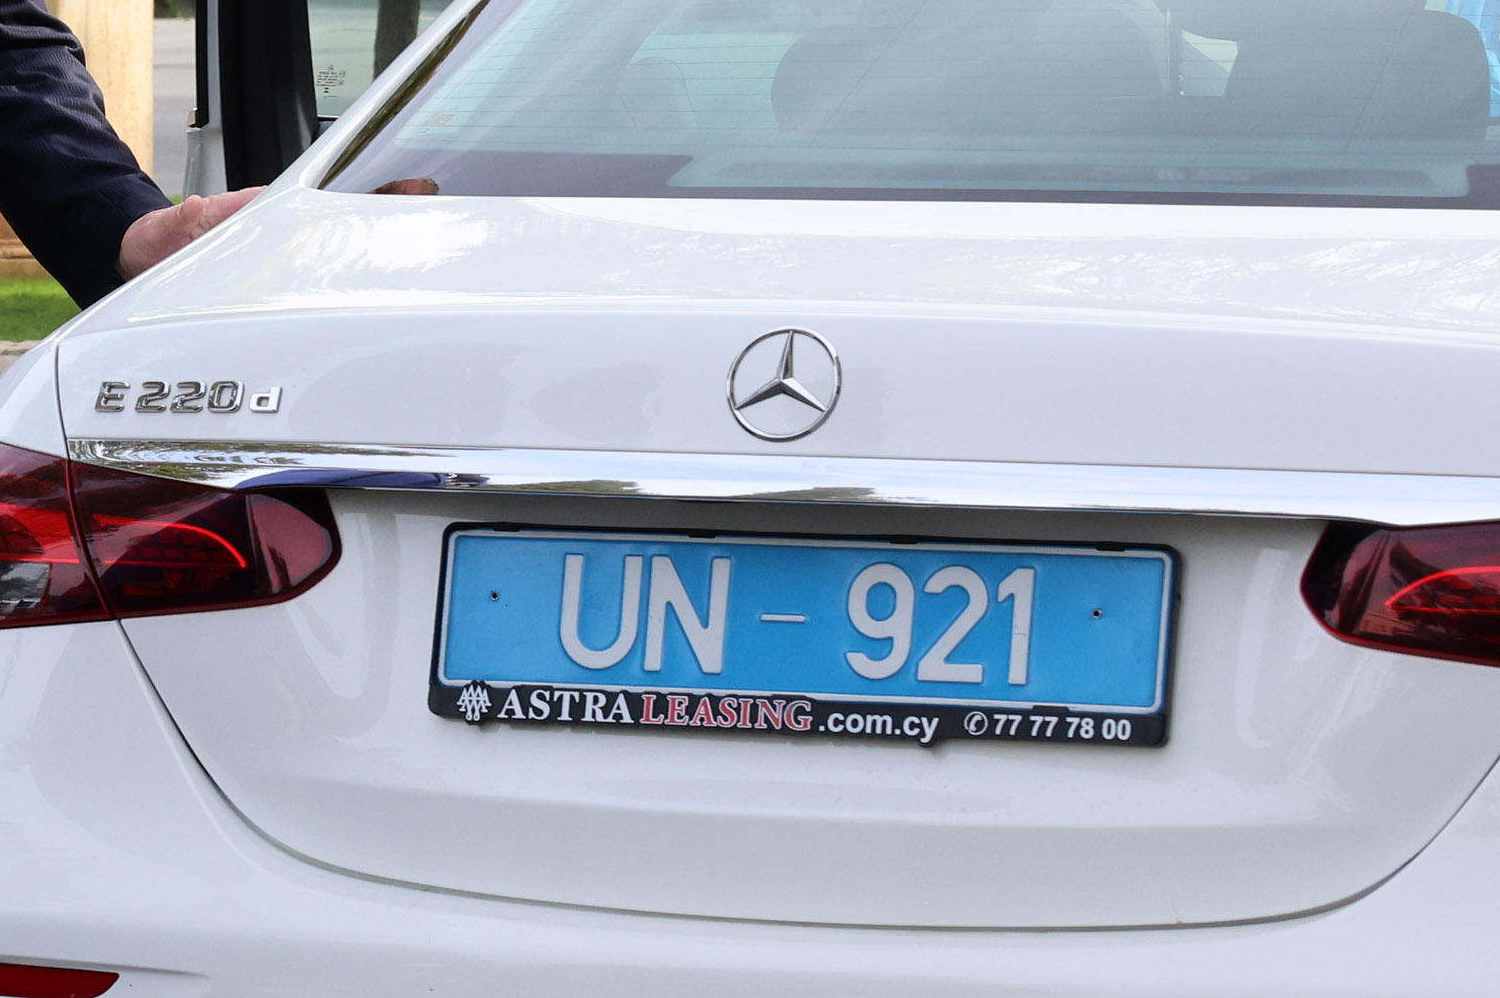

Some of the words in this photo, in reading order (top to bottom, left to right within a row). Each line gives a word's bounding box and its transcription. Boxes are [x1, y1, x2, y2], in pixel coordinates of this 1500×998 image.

[95, 381, 130, 413] E
[558, 553, 732, 675] UN
[844, 562, 1037, 686] 921
[497, 688, 634, 724] ASTRA
[993, 713, 1023, 736] 77
[1029, 715, 1059, 738] 77
[1066, 717, 1096, 739] 78
[1102, 719, 1132, 741] 00
